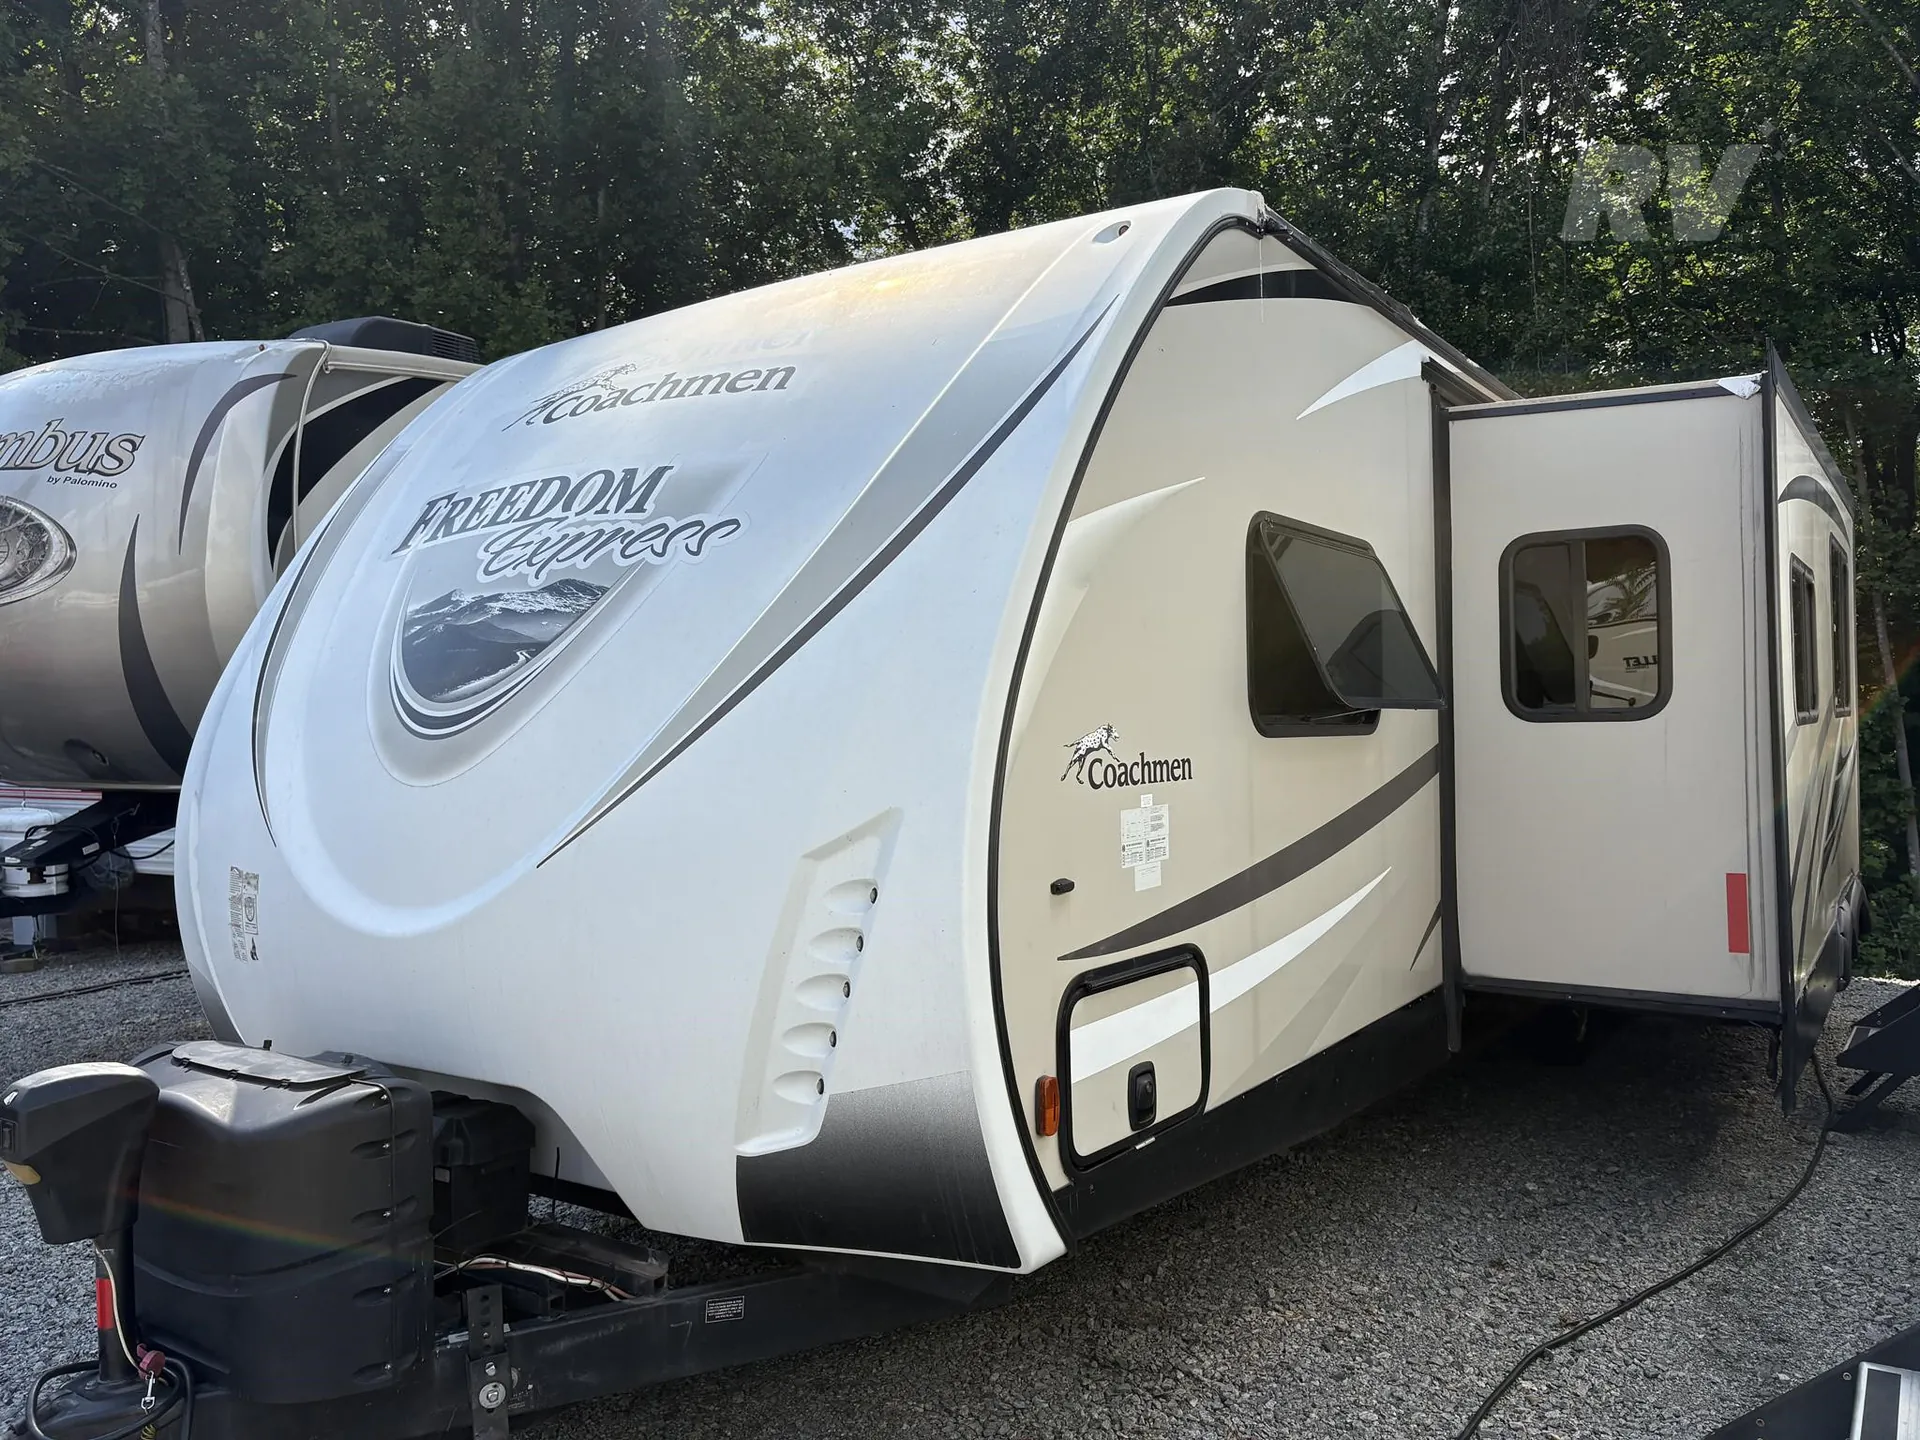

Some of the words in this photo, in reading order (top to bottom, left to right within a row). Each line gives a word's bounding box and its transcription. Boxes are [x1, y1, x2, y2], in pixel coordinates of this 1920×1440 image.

[542, 365, 797, 425] Coachmen
[47, 475, 61, 485] by
[63, 476, 118, 489] Palomino
[392, 465, 674, 555] FREEDOM
[483, 515, 742, 580] Express
[1088, 752, 1193, 790] Coachmen
